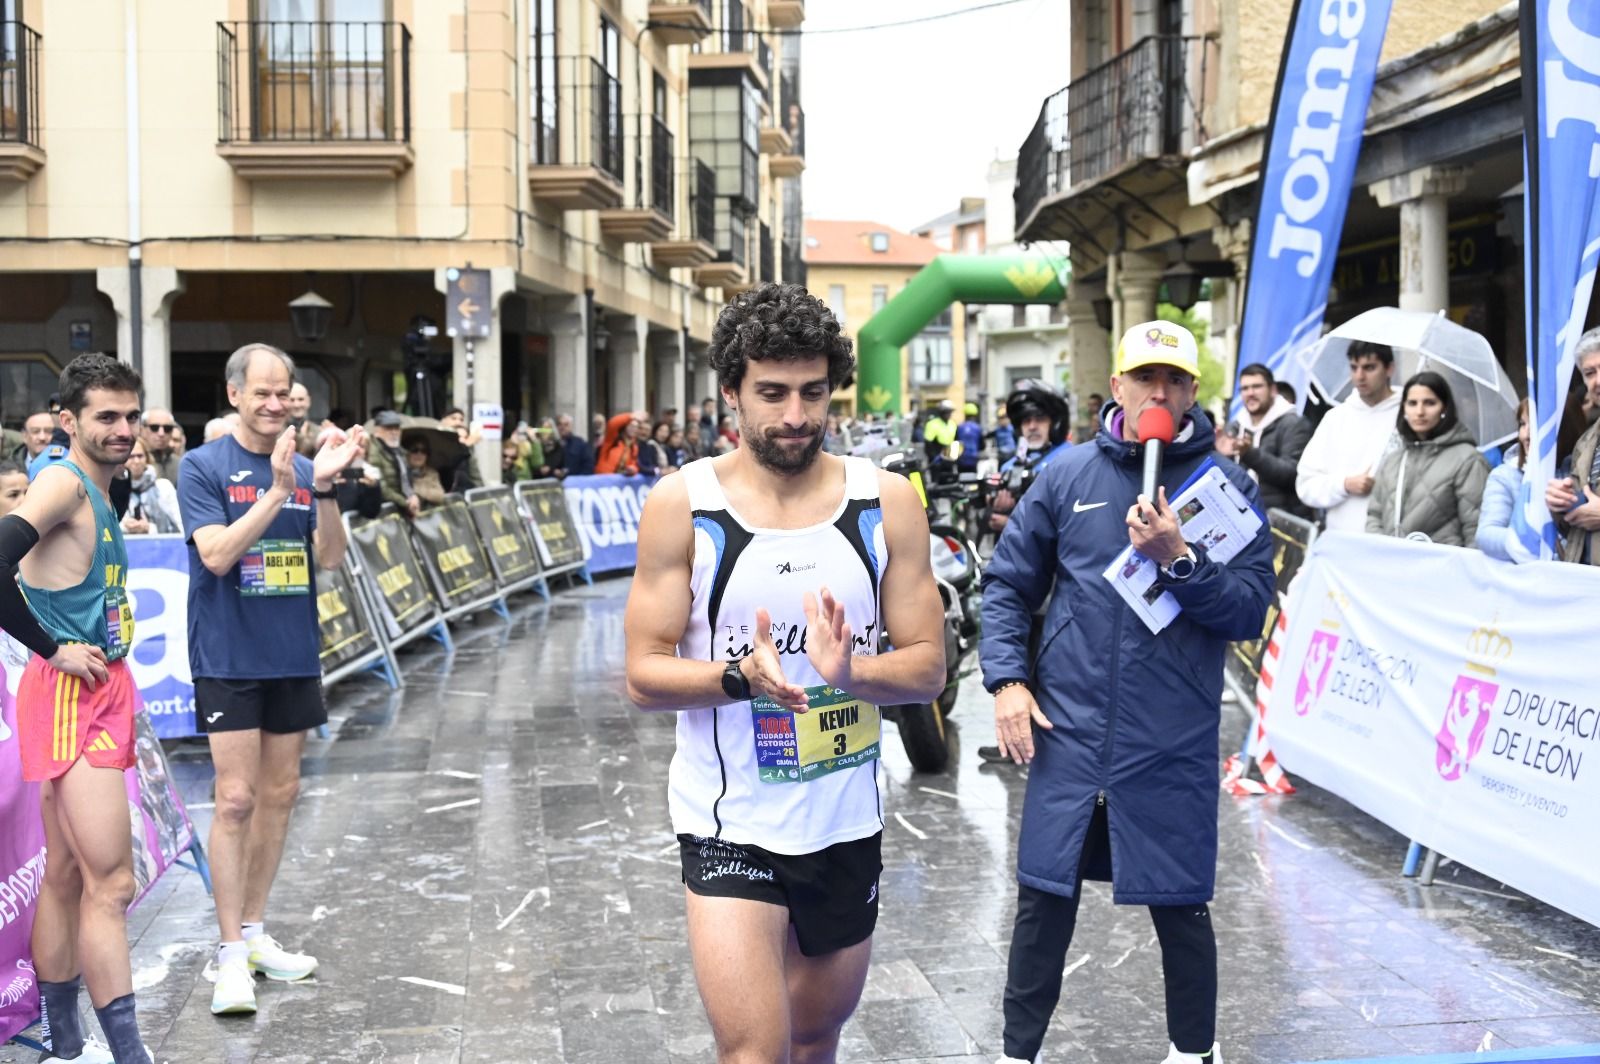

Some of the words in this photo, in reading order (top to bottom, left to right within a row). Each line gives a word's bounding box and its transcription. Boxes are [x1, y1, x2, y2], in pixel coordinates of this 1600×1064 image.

[266, 556, 283, 567] ABEL
[285, 570, 290, 584] 1
[725, 621, 786, 635] TEM
[819, 705, 859, 732] KEVIN
[1503, 688, 1600, 741] DIPUTACI
[758, 716, 792, 734] 10K
[757, 739, 796, 747] ASTORGA
[833, 733, 847, 756] 3
[1492, 727, 1522, 761] DE
[1522, 736, 1583, 782] LEÓN
[1481, 775, 1519, 800] DEPORTES
[1522, 792, 1569, 818] JUVENTUD
